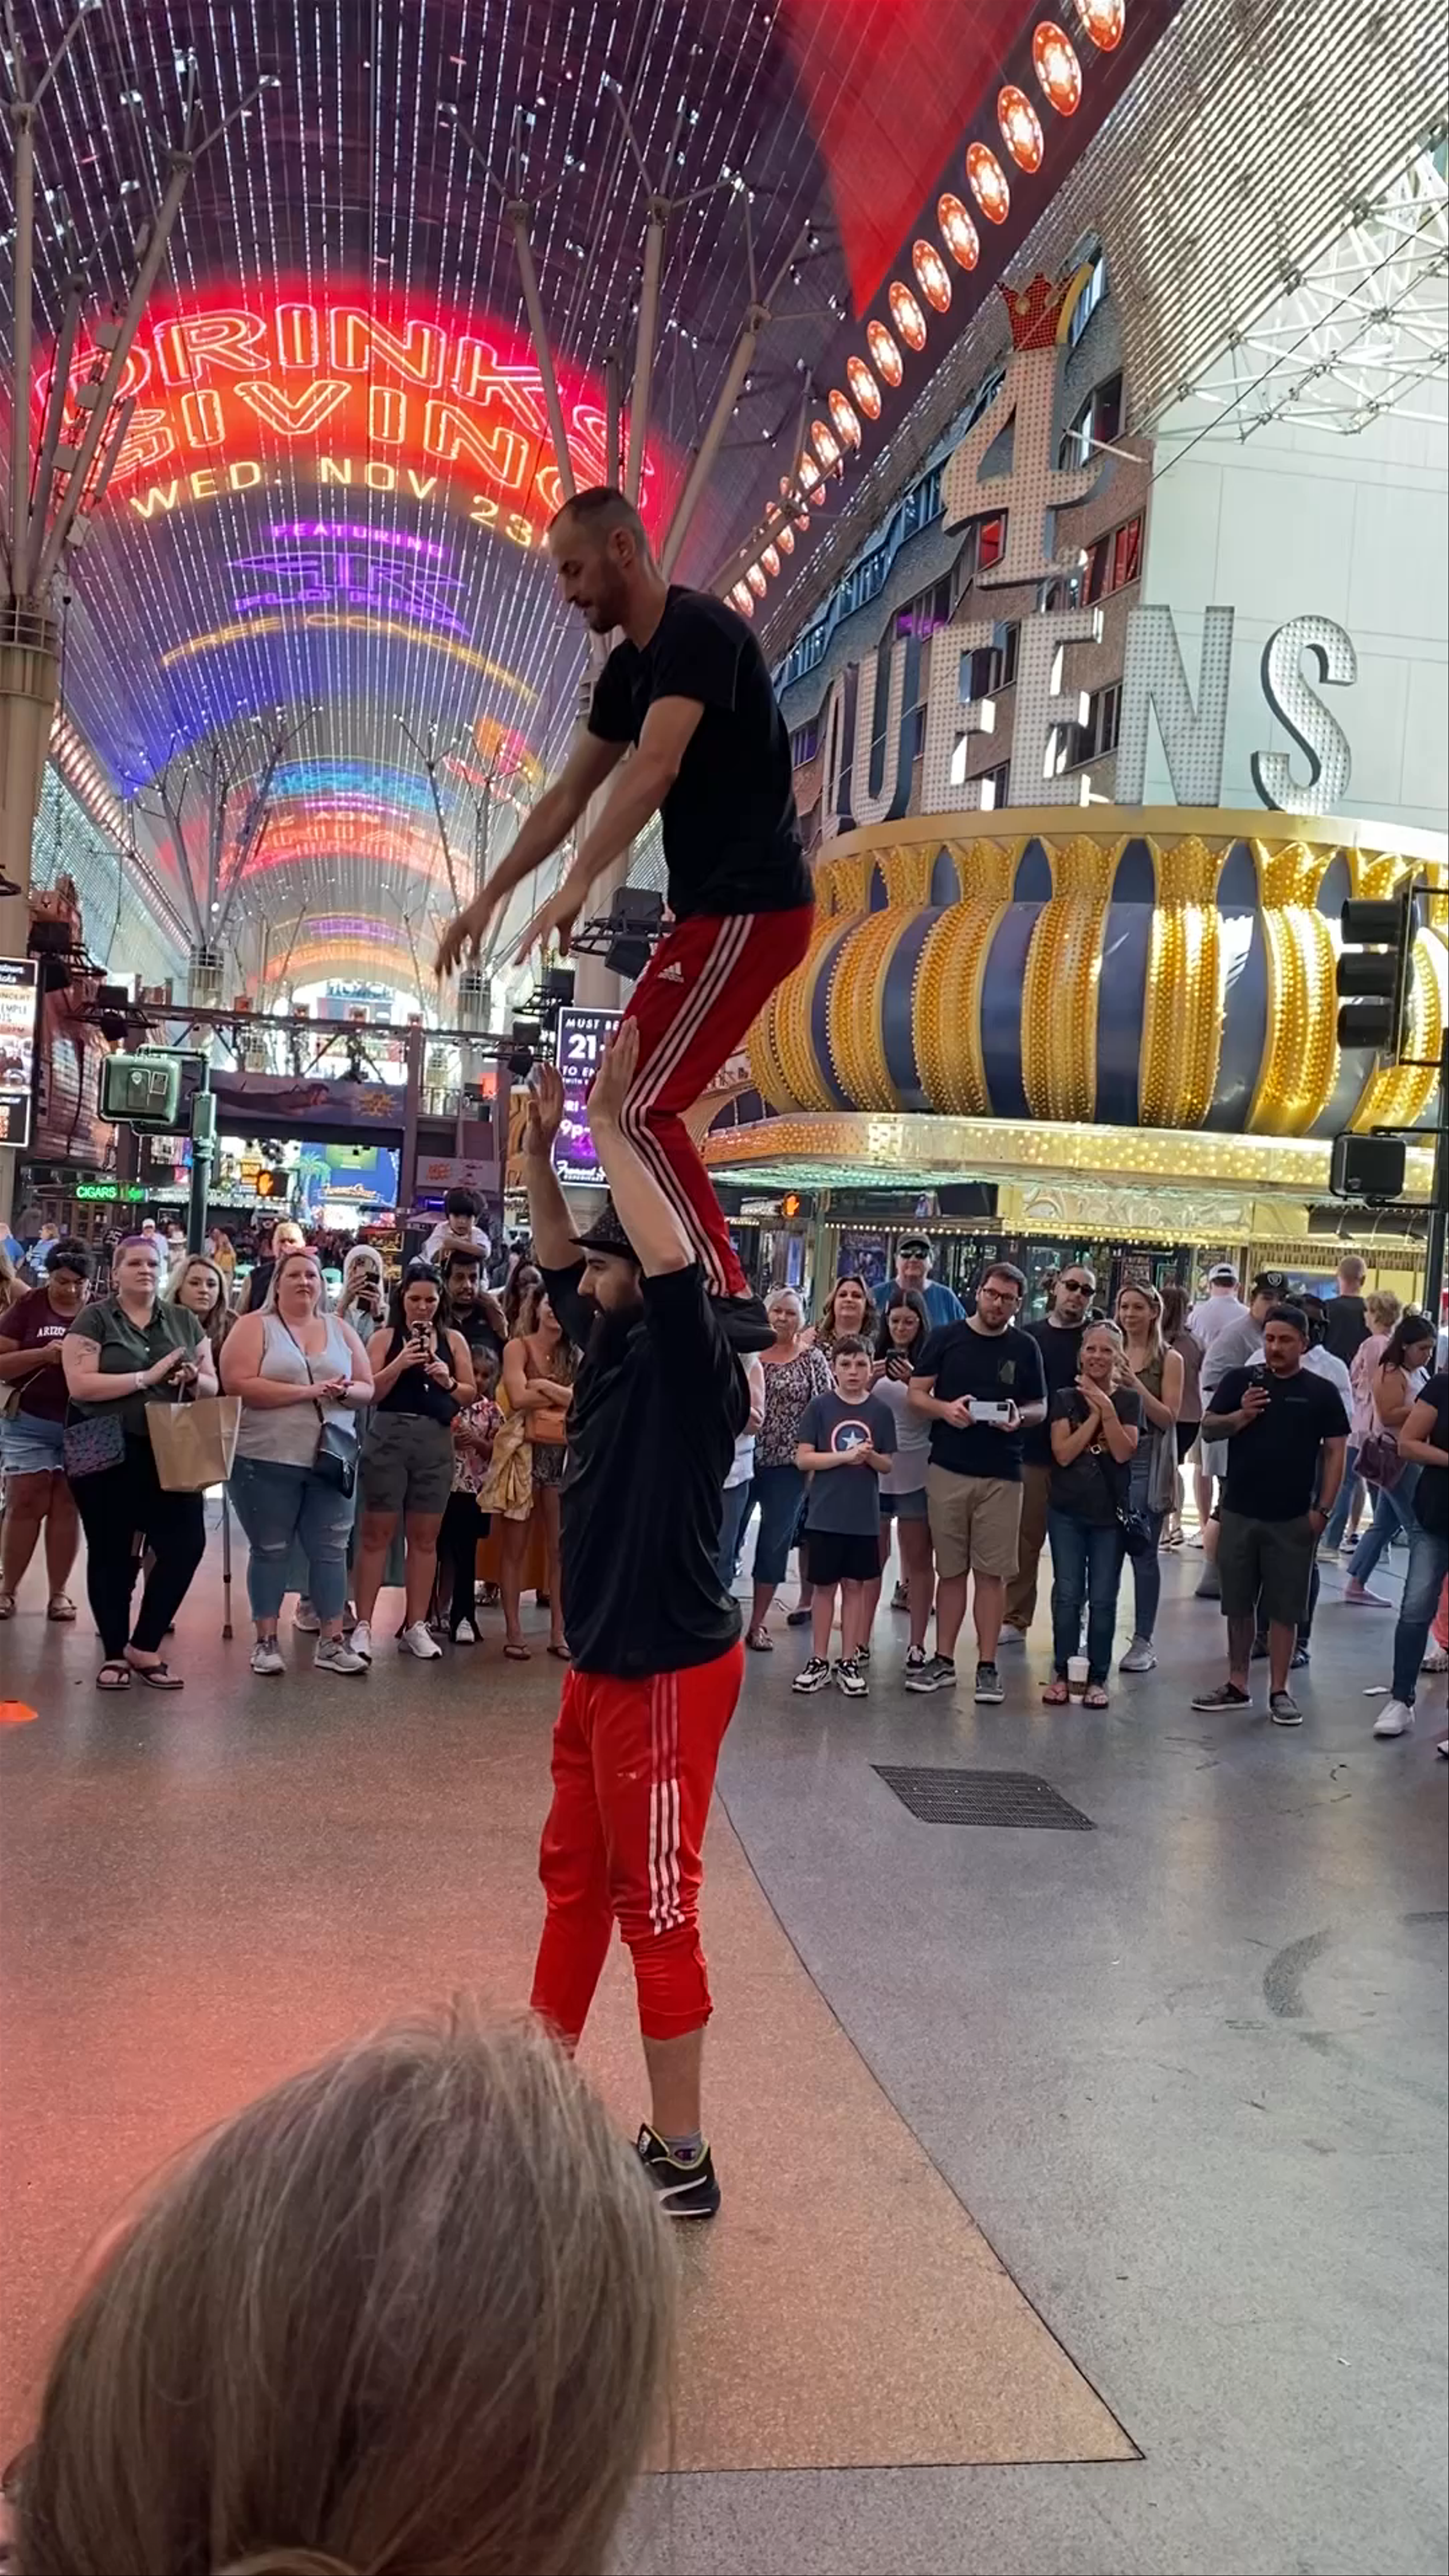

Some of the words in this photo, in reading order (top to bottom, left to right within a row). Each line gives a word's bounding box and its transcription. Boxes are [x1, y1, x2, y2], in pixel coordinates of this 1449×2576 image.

[942, 345, 1110, 589] 4
[320, 457, 438, 499] NOV
[272, 523, 445, 558] FEATURING
[566, 1018, 600, 1029] MUST
[605, 1020, 620, 1031] BE
[562, 1065, 578, 1076] TO
[77, 1186, 117, 1199] CIGARS
[37, 1326, 66, 1338] ARIZO
